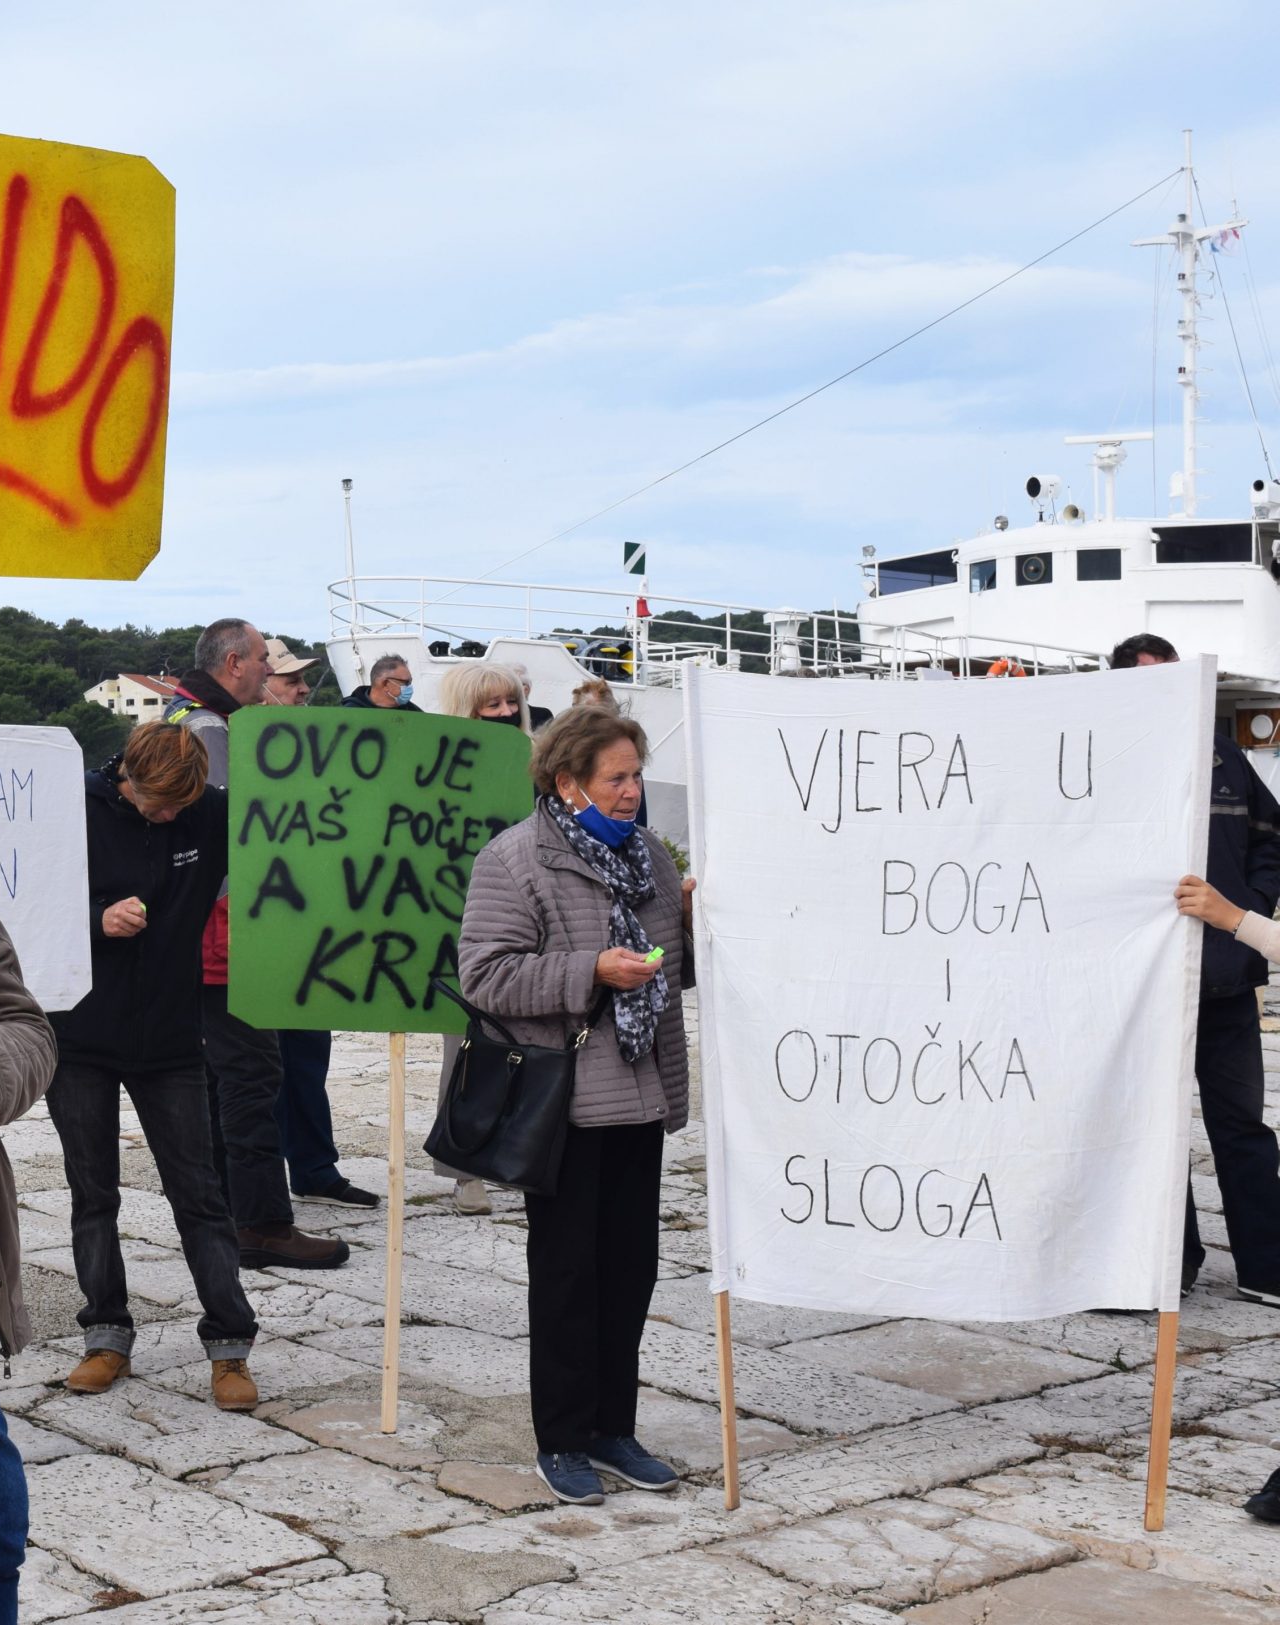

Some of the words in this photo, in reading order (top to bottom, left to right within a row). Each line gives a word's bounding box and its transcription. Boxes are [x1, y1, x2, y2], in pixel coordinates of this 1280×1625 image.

[255, 722, 387, 780] OVO
[415, 735, 481, 792] JE
[777, 728, 973, 834] VJERA
[1057, 729, 1093, 801] U
[238, 786, 351, 846] NAŠ
[384, 799, 520, 855] POČET
[249, 857, 306, 918] A
[882, 859, 1050, 936] BOGA
[945, 957, 952, 1003] I
[774, 1022, 1035, 1105] OTOČKA
[780, 1154, 1003, 1241] SLOGA
